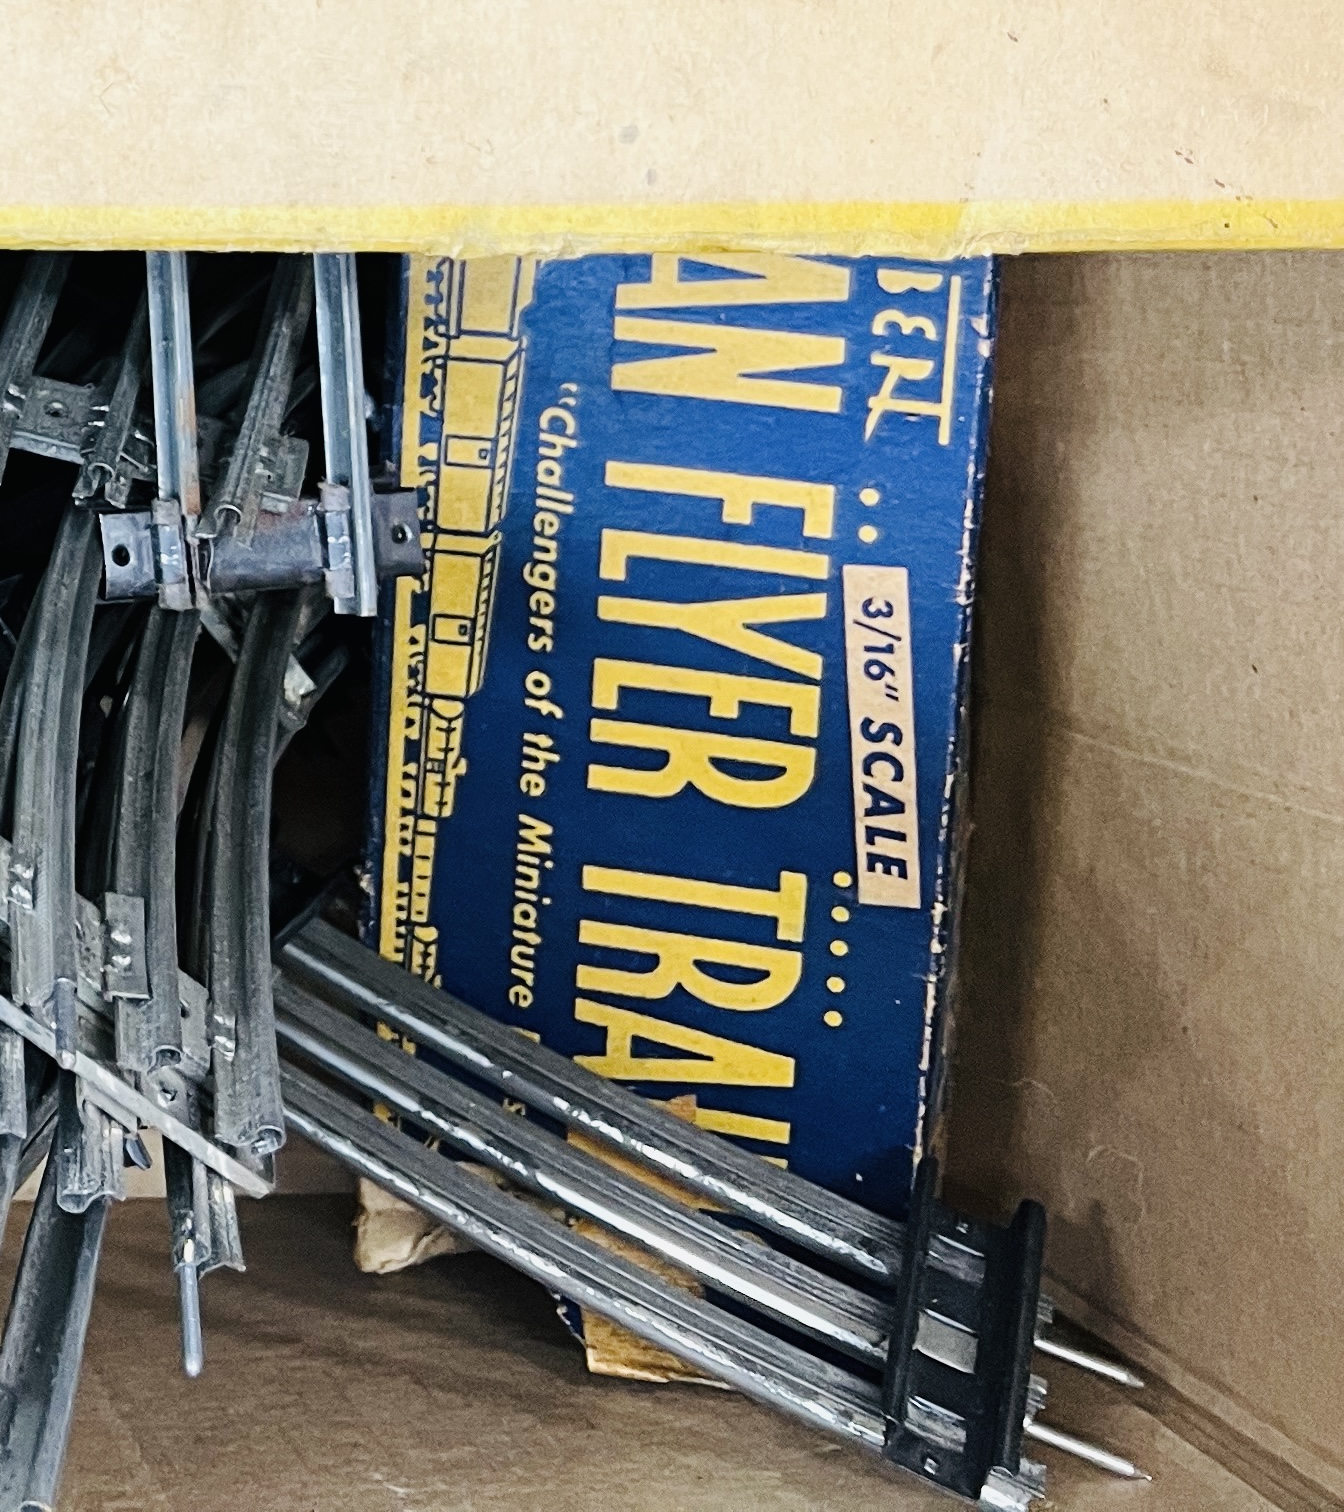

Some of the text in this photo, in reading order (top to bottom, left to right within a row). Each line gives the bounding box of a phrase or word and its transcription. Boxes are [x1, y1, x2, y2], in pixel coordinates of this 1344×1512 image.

[522, 669, 565, 720] of
[586, 459, 837, 810] FLYER
[518, 732, 561, 798] the
[858, 715, 909, 883] SCALE
[508, 812, 555, 1009] Miniature
